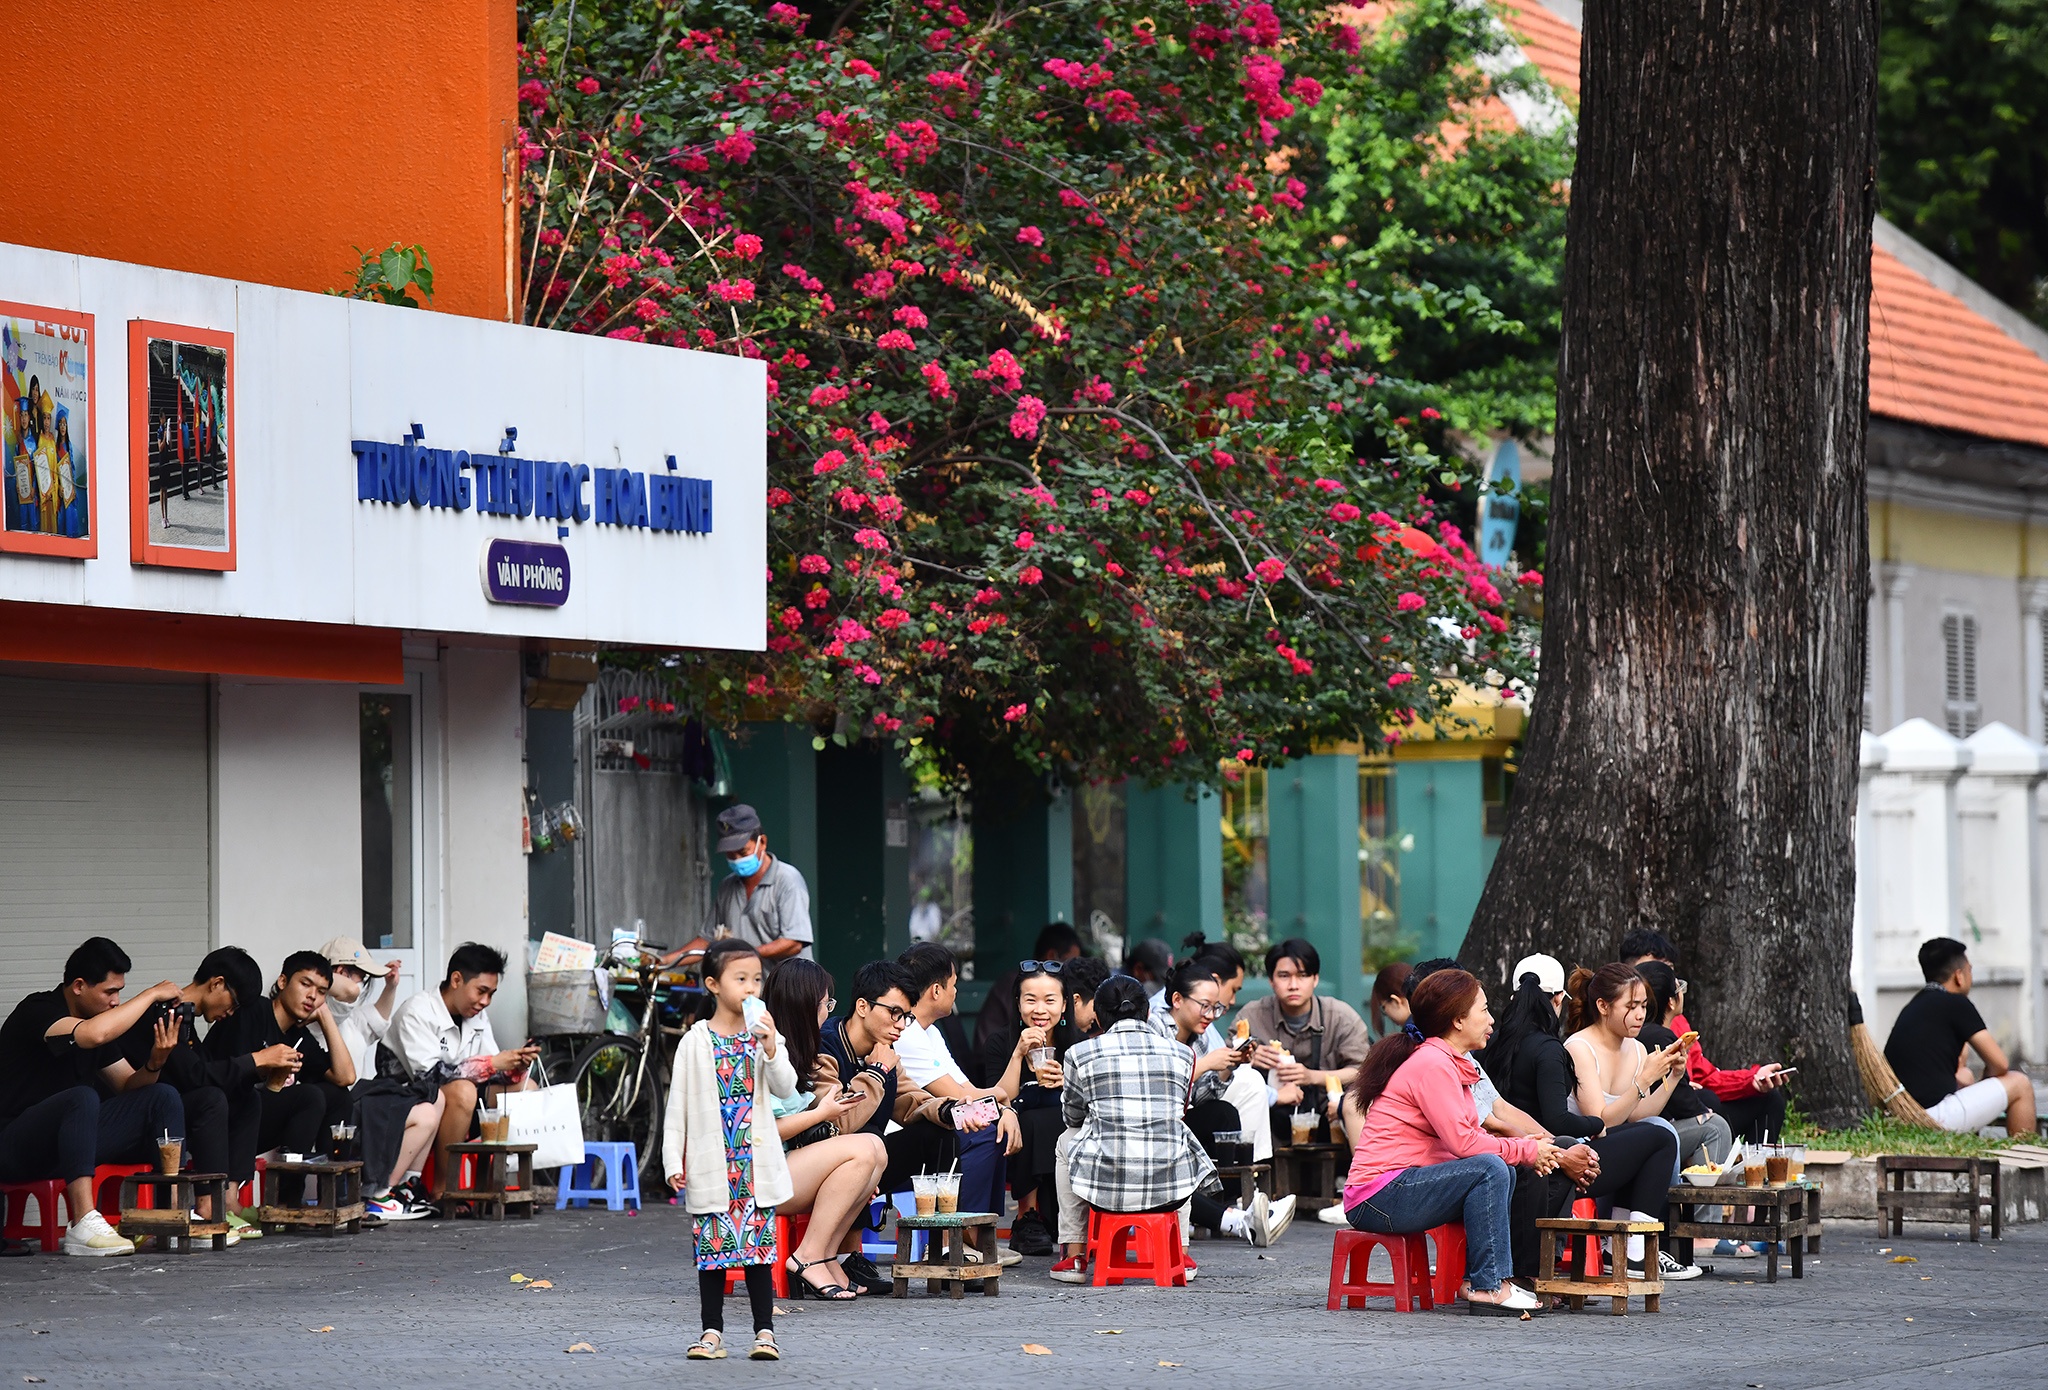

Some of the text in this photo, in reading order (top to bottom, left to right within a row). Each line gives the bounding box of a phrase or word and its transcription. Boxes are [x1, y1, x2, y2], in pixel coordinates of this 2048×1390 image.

[55, 386, 70, 399] NĂM
[351, 423, 471, 510] TRƯỜNG
[471, 427, 533, 517] TIỂU
[534, 461, 590, 538] HỌC
[649, 454, 712, 533] BÌNH
[497, 555, 564, 591] VĂN PHÒNG
[516, 1124, 566, 1137] liniss
